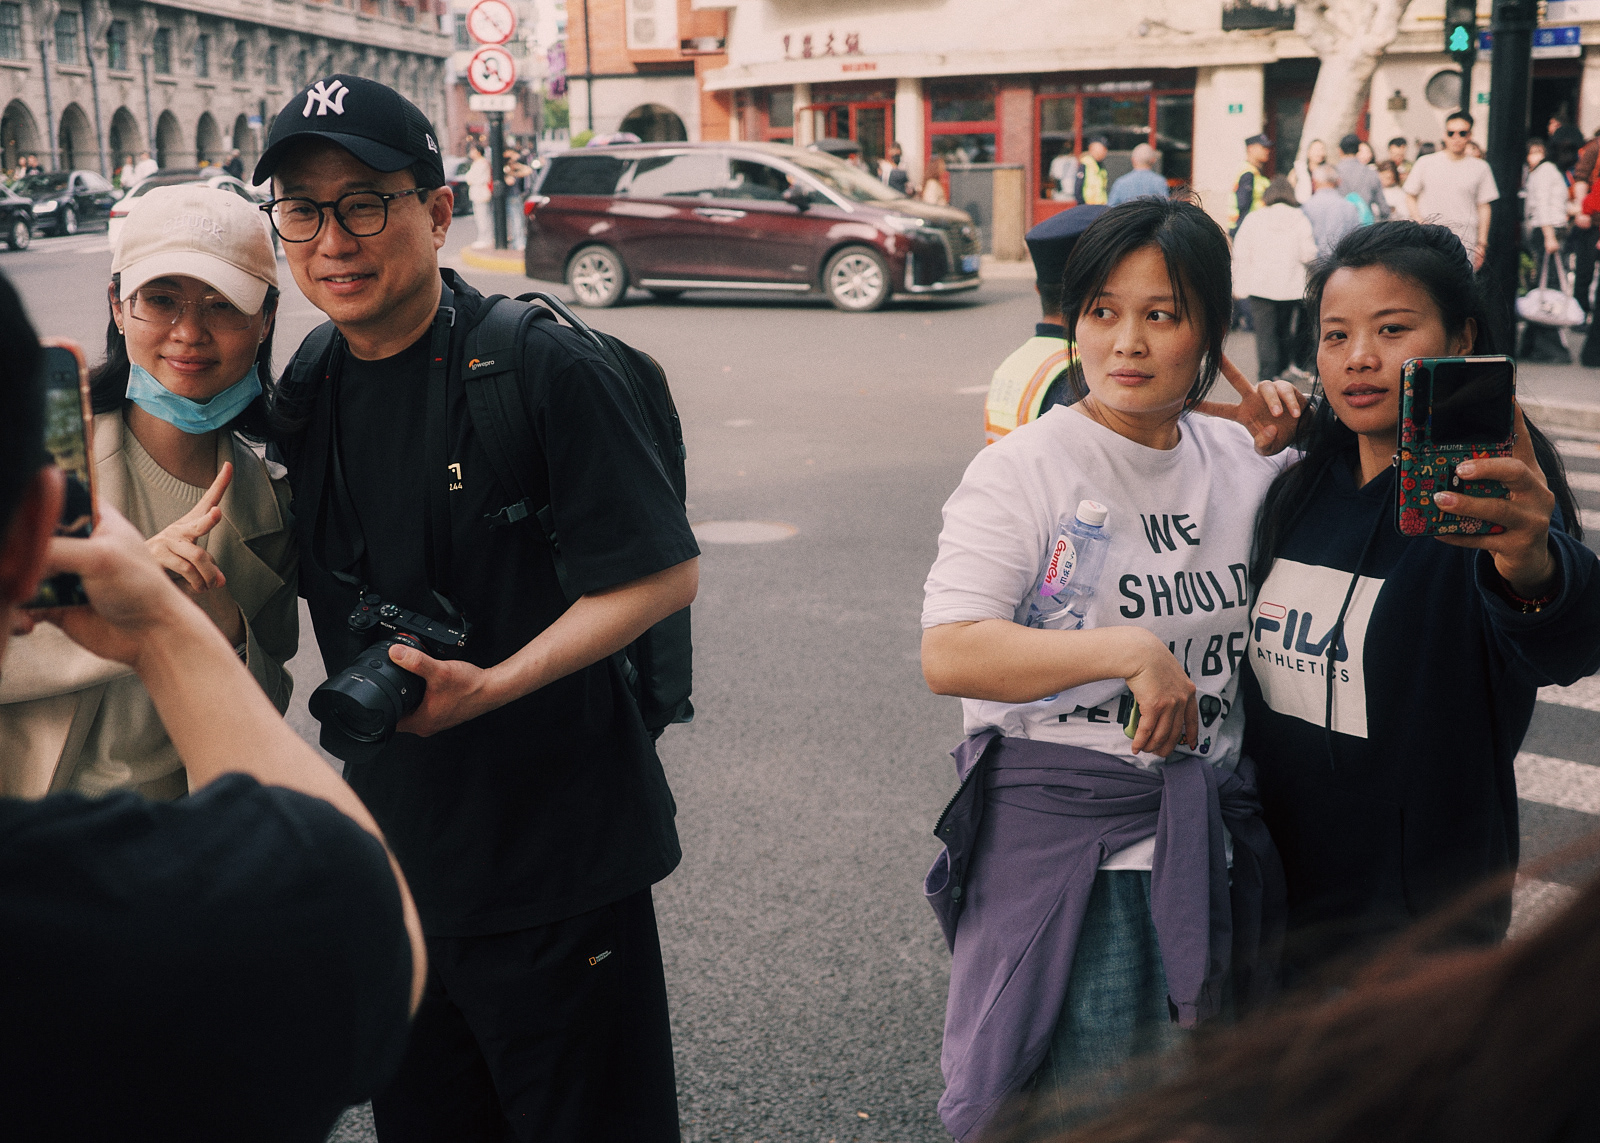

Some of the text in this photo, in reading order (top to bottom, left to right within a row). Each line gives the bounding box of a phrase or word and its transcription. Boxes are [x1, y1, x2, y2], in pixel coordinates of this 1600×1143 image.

[302, 80, 349, 118] NY
[162, 213, 226, 243] CHUCK
[1140, 513, 1200, 553] WE
[1119, 562, 1247, 619] SHOULD
[1254, 604, 1349, 662] FILA
